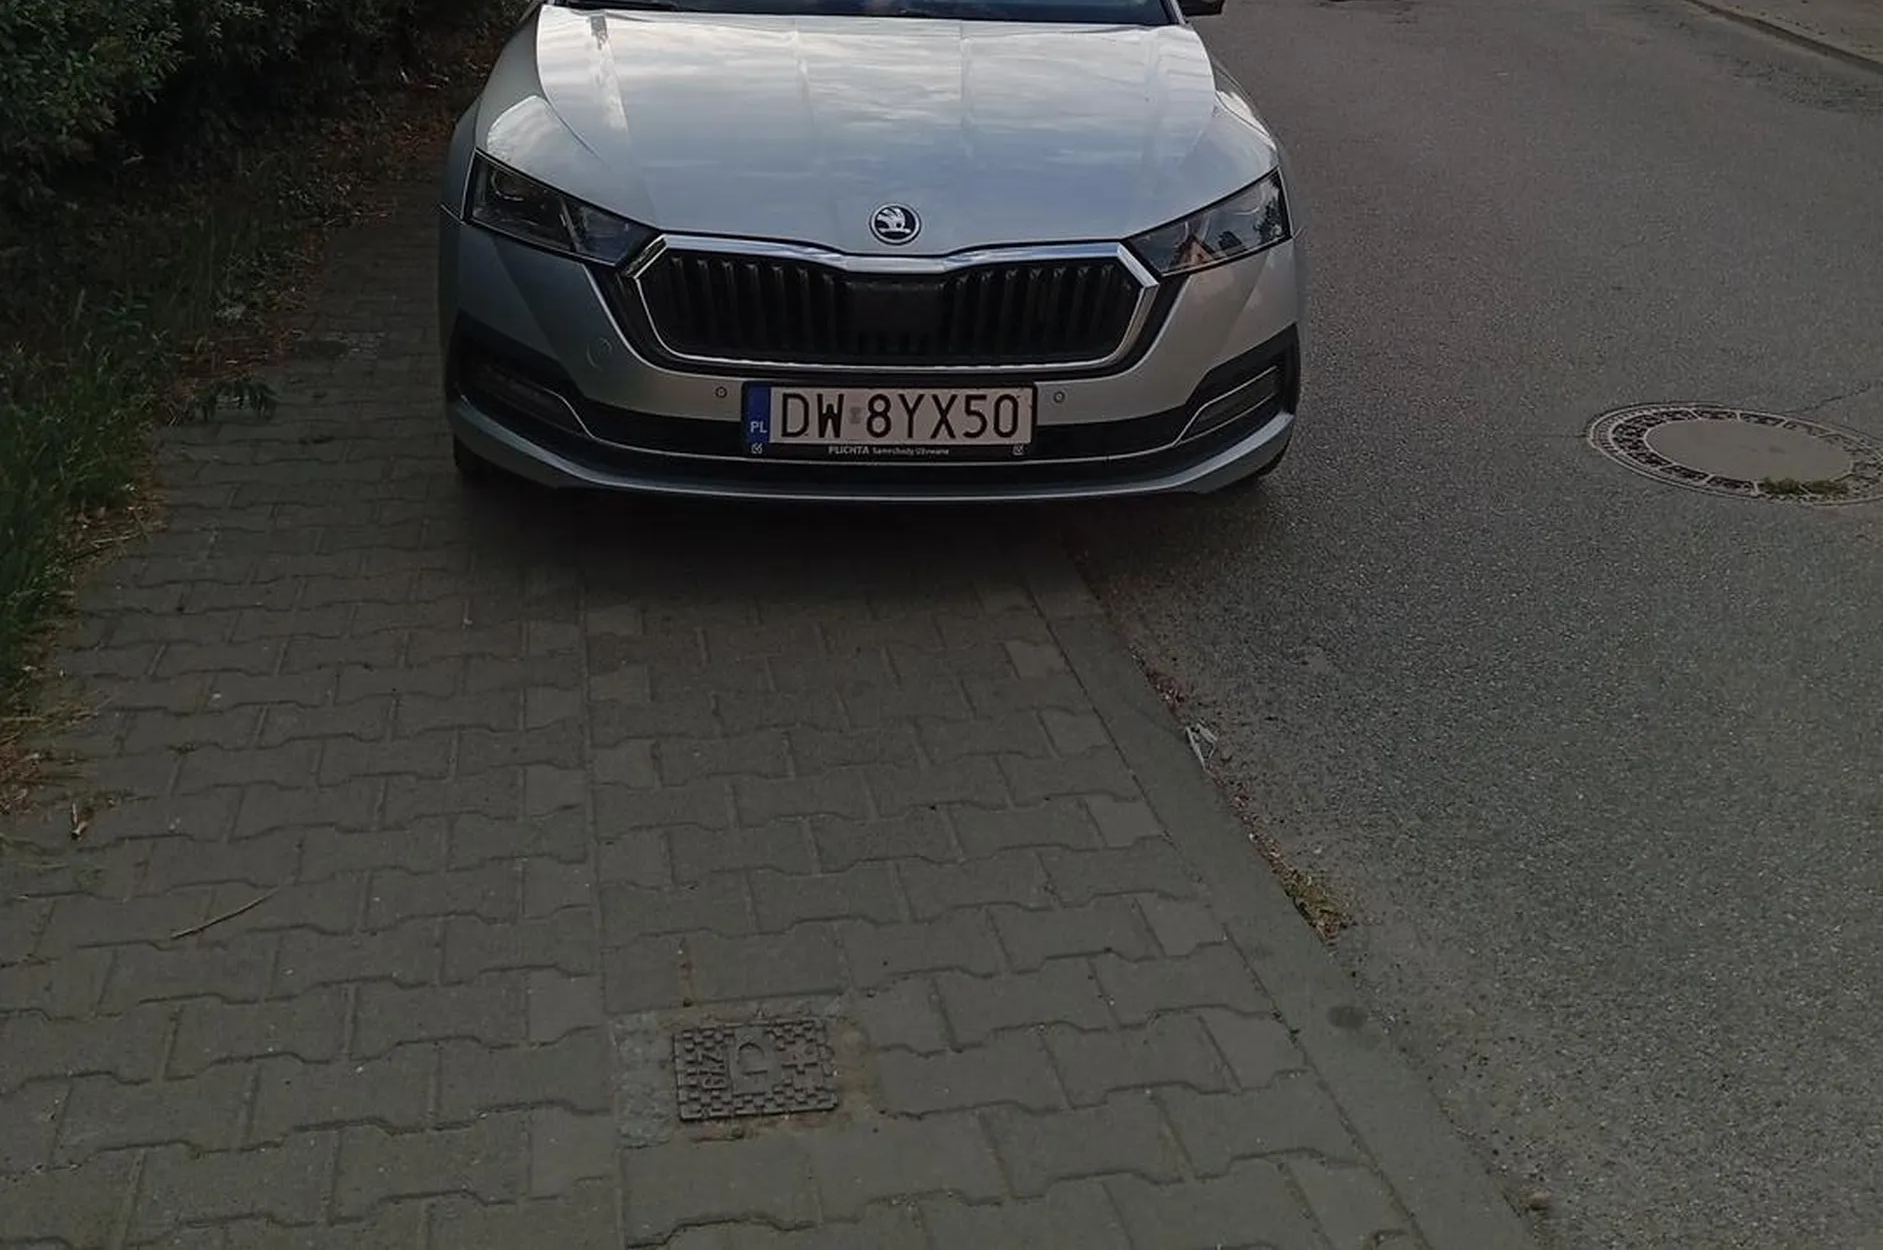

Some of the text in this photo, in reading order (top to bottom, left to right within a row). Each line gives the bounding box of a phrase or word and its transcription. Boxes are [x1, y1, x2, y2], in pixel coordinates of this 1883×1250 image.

[780, 393, 1020, 439] DW 8YX50
[750, 421, 768, 433] PL
[828, 445, 870, 455] PLICHTA
